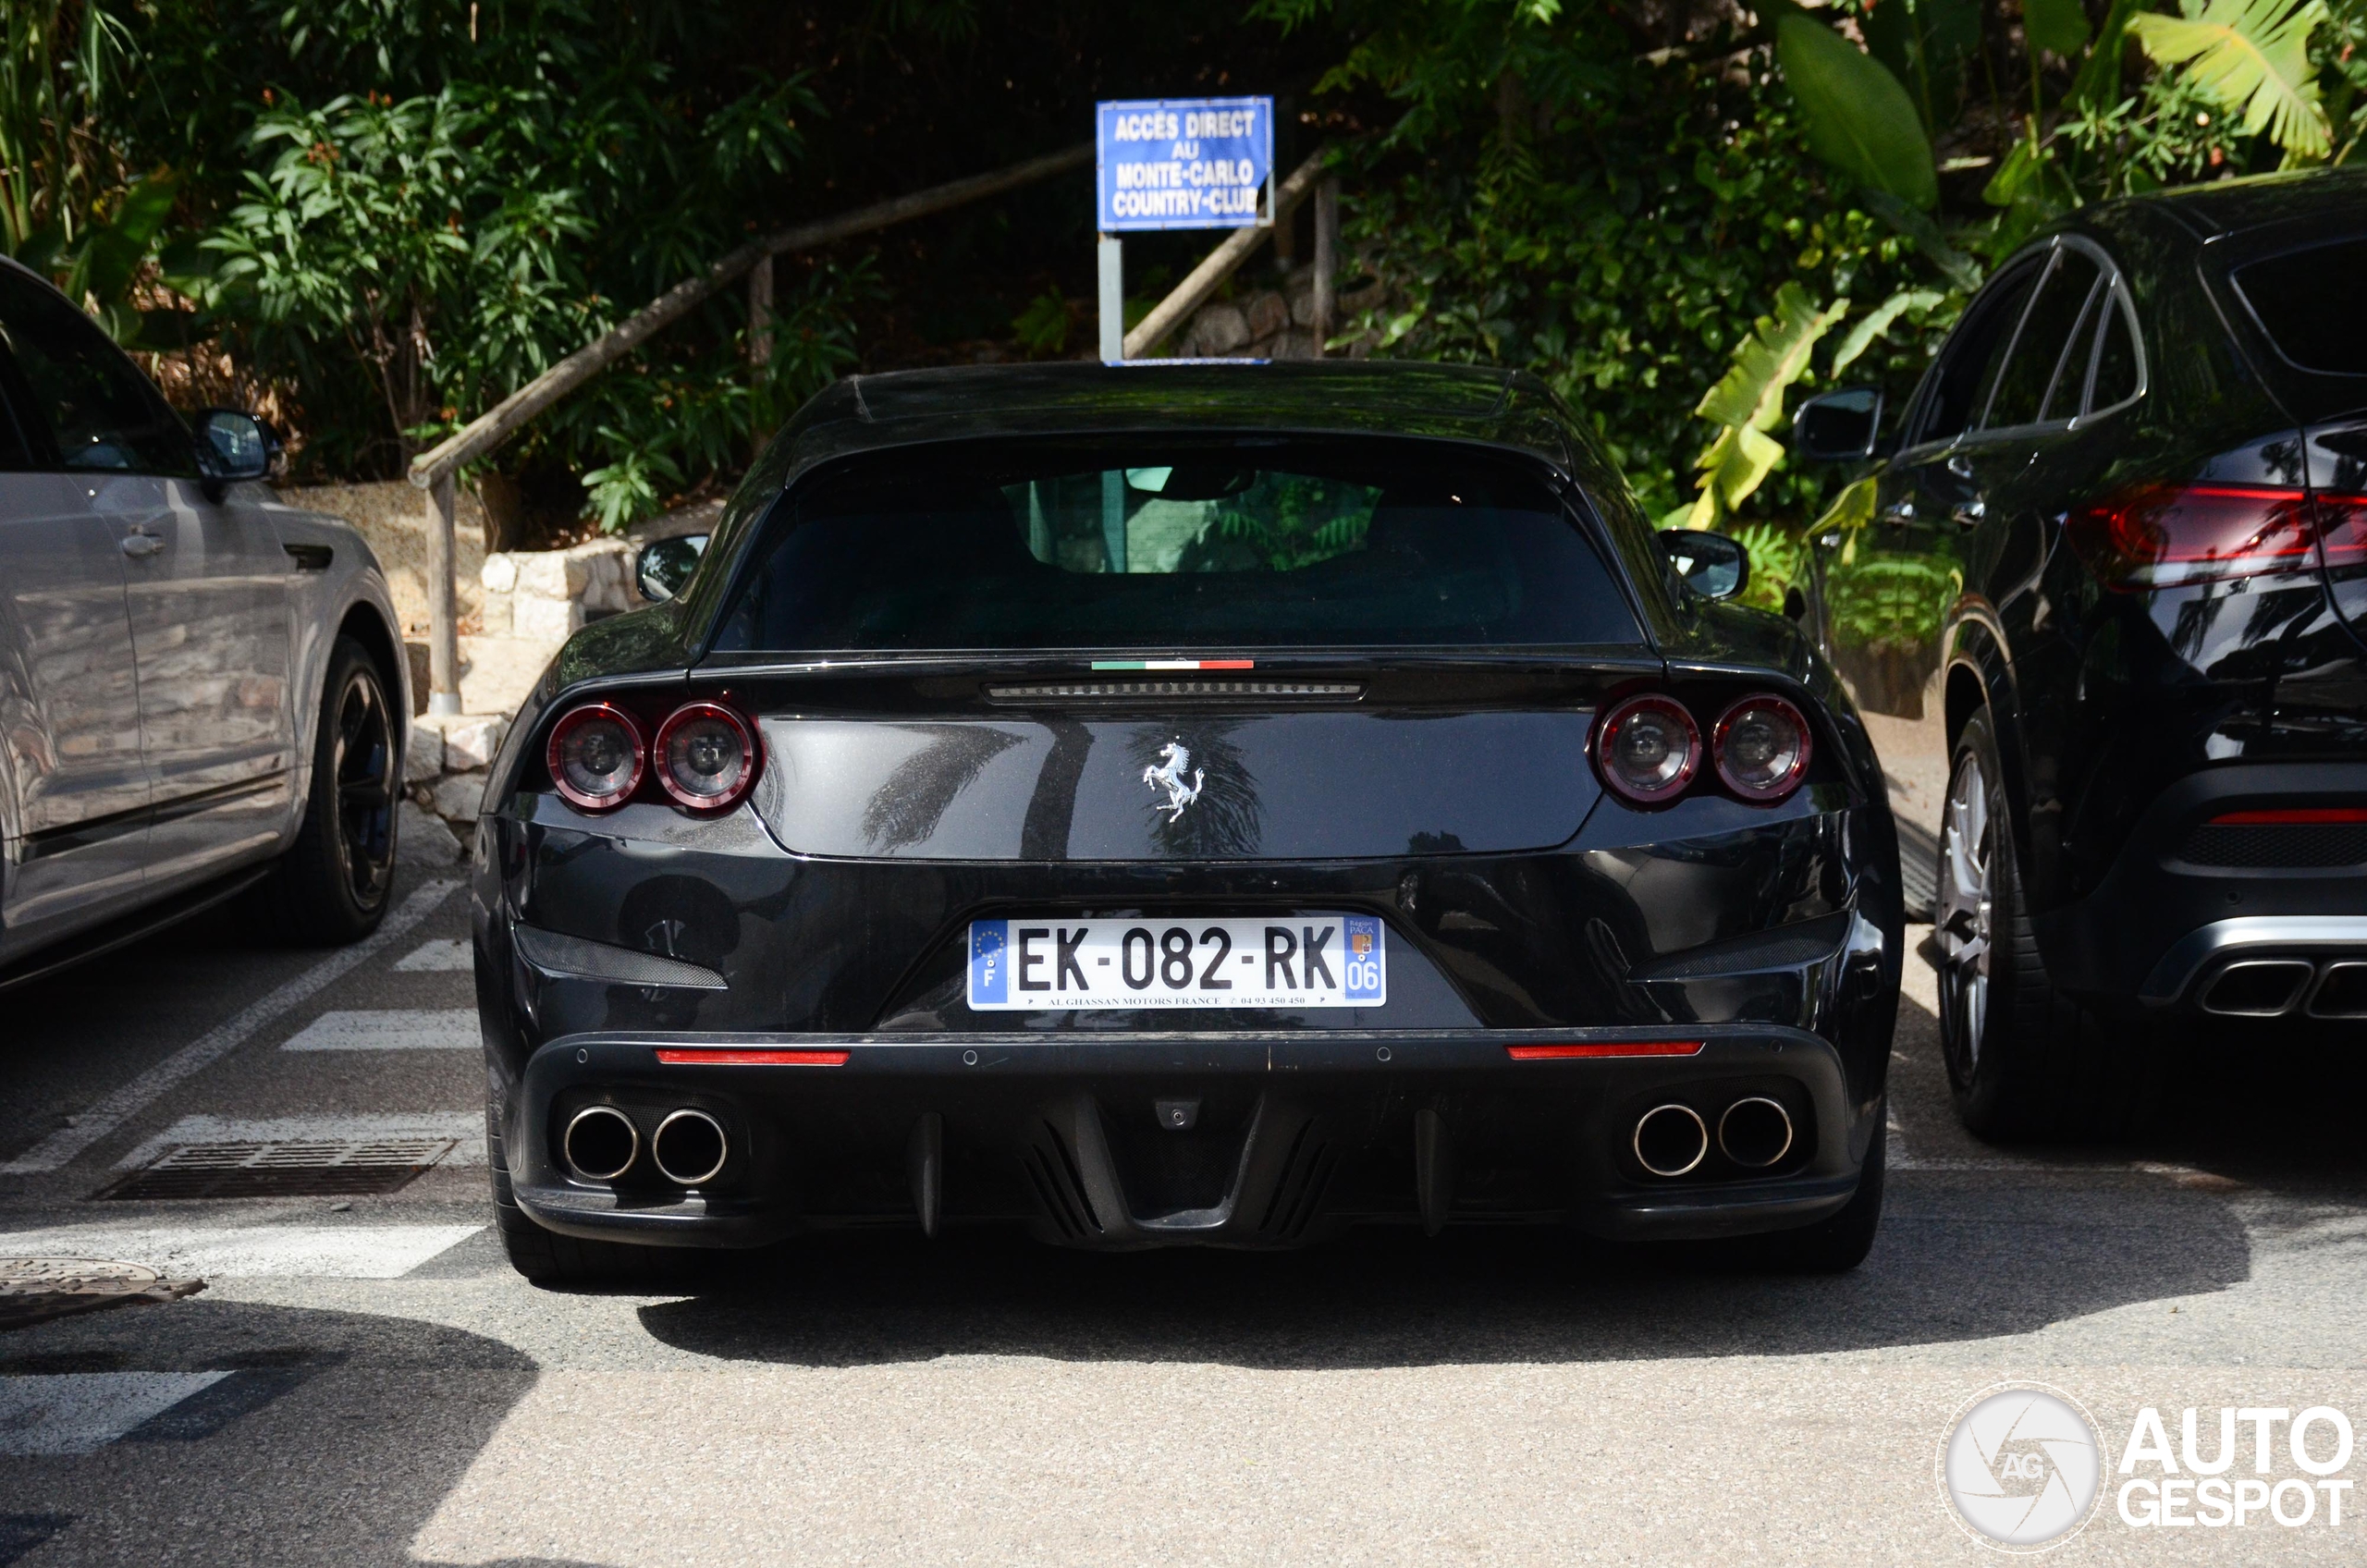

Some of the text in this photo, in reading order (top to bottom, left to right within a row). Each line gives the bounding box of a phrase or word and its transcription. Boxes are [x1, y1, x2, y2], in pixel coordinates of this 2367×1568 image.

[1185, 110, 1256, 139] DIRECT
[1171, 141, 1200, 160] AU
[1116, 159, 1255, 190] MONTE-CARLO
[1019, 926, 1337, 991] EK-082-RK
[984, 969, 996, 987] F
[1347, 962, 1379, 990] 06
[1122, 998, 1172, 1006] MOTORS
[1175, 997, 1221, 1005] FRANCE
